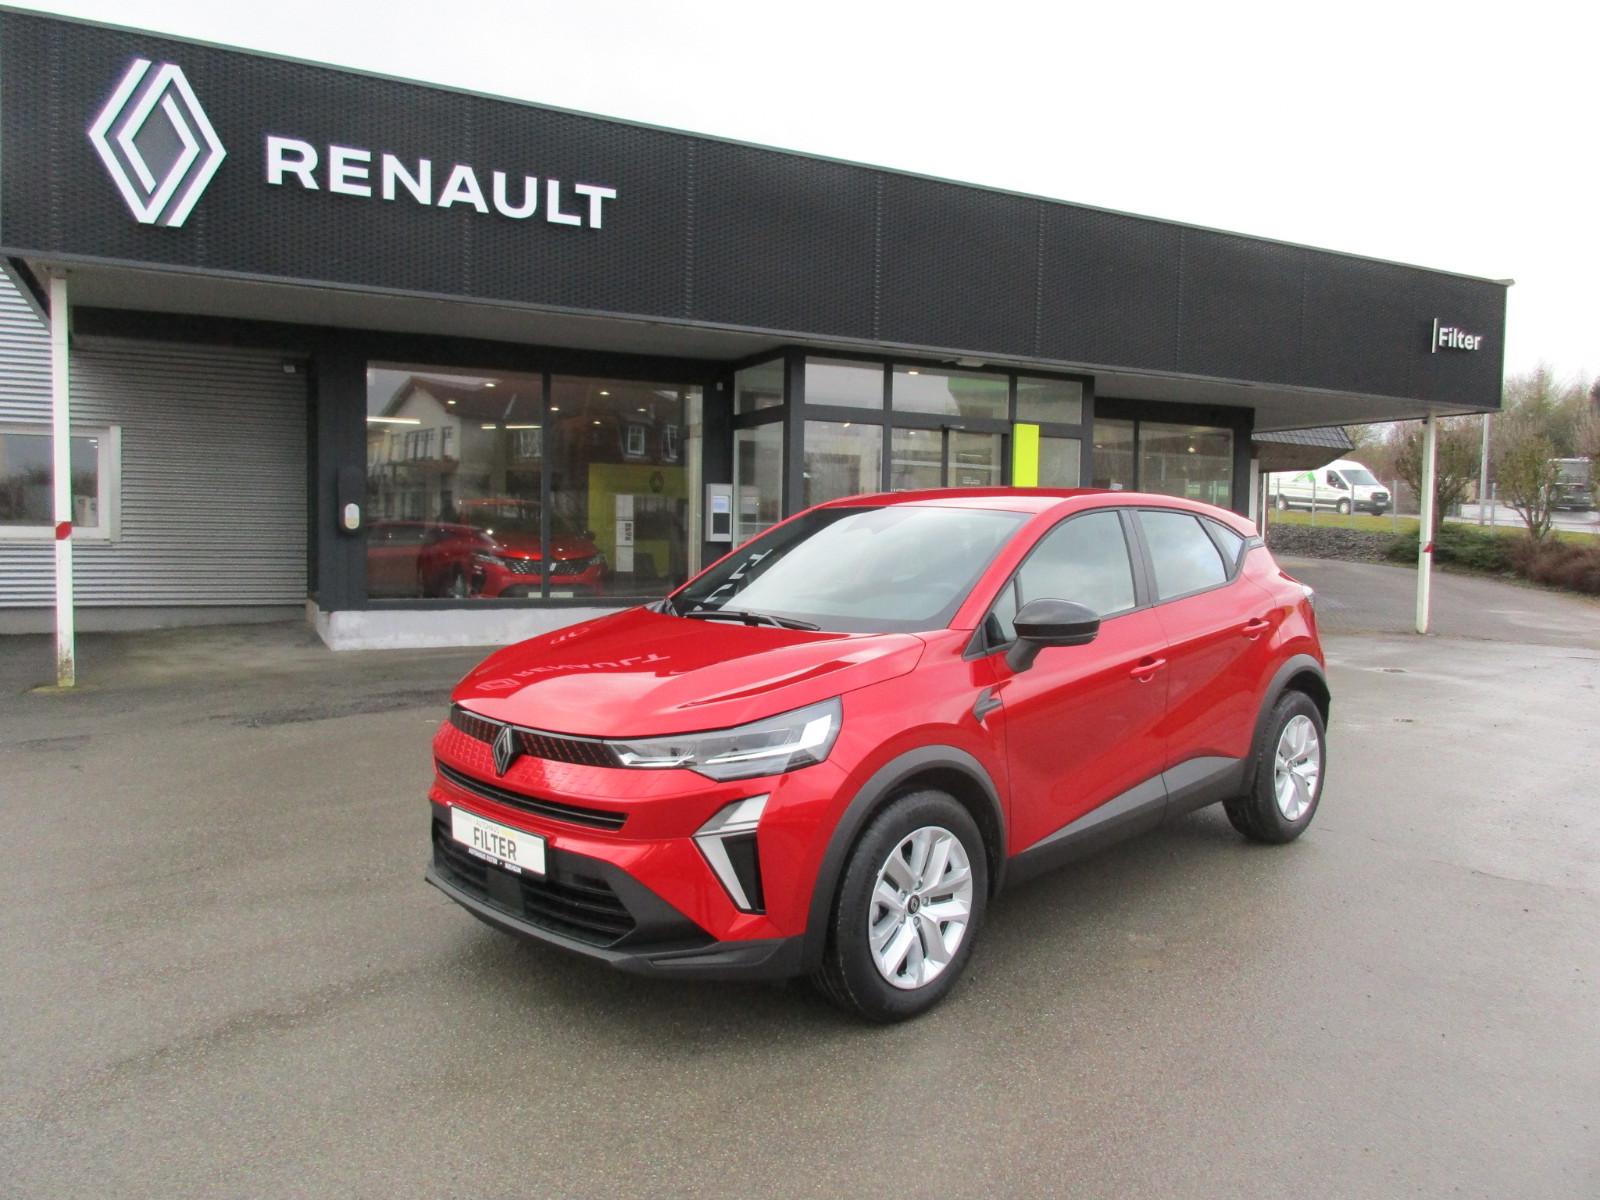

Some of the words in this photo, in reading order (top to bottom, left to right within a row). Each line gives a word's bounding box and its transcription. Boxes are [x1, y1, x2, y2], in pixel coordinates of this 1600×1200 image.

[266, 135, 617, 229] RENAULT
[1438, 327, 1482, 350] Filter
[473, 826, 517, 861] FILTER
